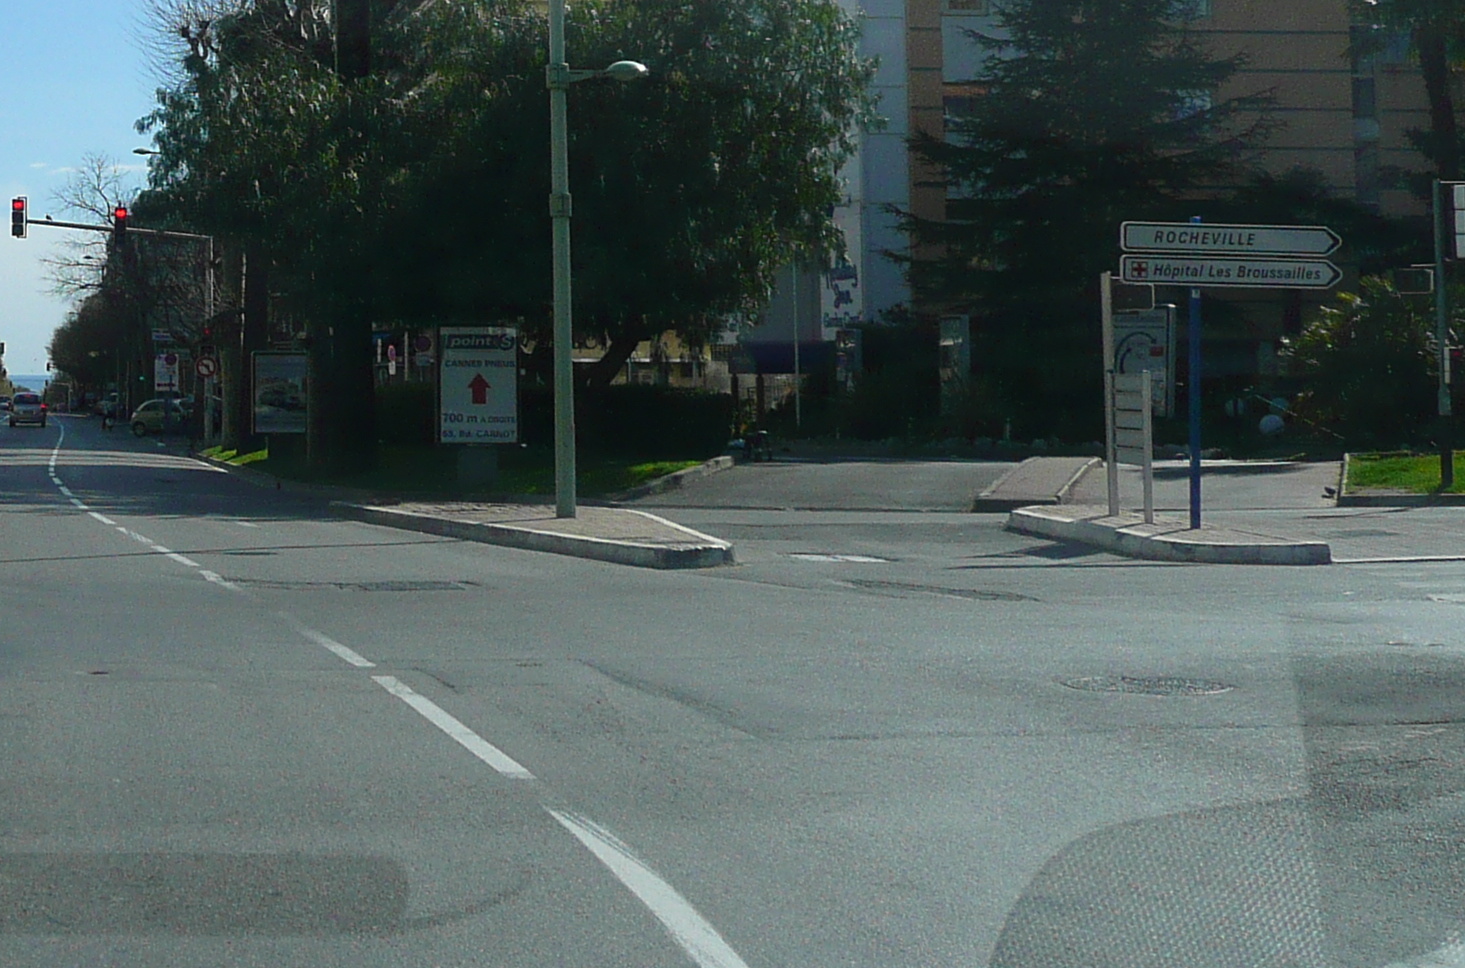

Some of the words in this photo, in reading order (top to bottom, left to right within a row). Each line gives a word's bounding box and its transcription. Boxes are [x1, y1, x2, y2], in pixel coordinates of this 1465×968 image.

[1153, 230, 1256, 246] ROCHEVILLE
[1153, 262, 1204, 279] Hôpital
[1208, 264, 1231, 278] Les
[1236, 265, 1322, 280] Broussailles
[450, 335, 491, 347] point
[499, 334, 513, 349] S
[443, 413, 464, 423] 700
